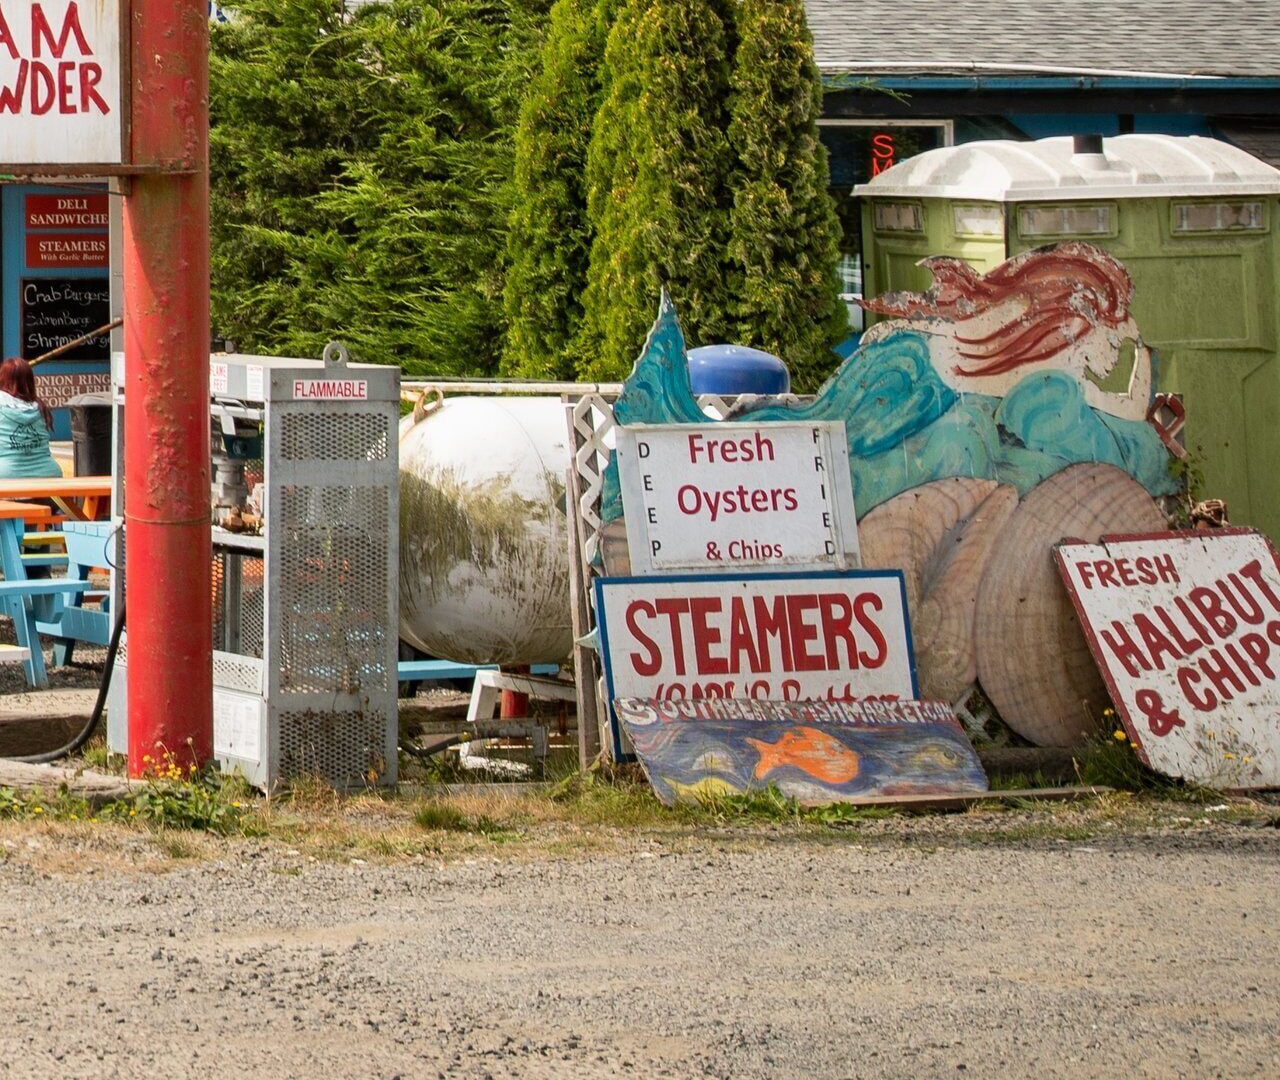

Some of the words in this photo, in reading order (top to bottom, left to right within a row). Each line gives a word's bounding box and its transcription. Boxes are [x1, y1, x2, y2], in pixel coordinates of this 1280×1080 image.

[57, 199, 88, 209] DELI
[30, 214, 108, 224] SANDWICHE
[39, 241, 106, 252] STEAMERS
[24, 284, 62, 306] Crab
[79, 374, 109, 385] RING
[295, 381, 366, 398] FLAMMABLE
[36, 386, 80, 397] RENCH
[688, 430, 775, 463] Fresh
[677, 484, 798, 522] Oysters
[706, 541, 723, 561] &
[728, 539, 783, 560] Chips
[1075, 553, 1181, 590] FRESH
[1099, 559, 1280, 678] HALIBUT
[625, 592, 888, 677] STEAMERS
[1135, 688, 1186, 737] &
